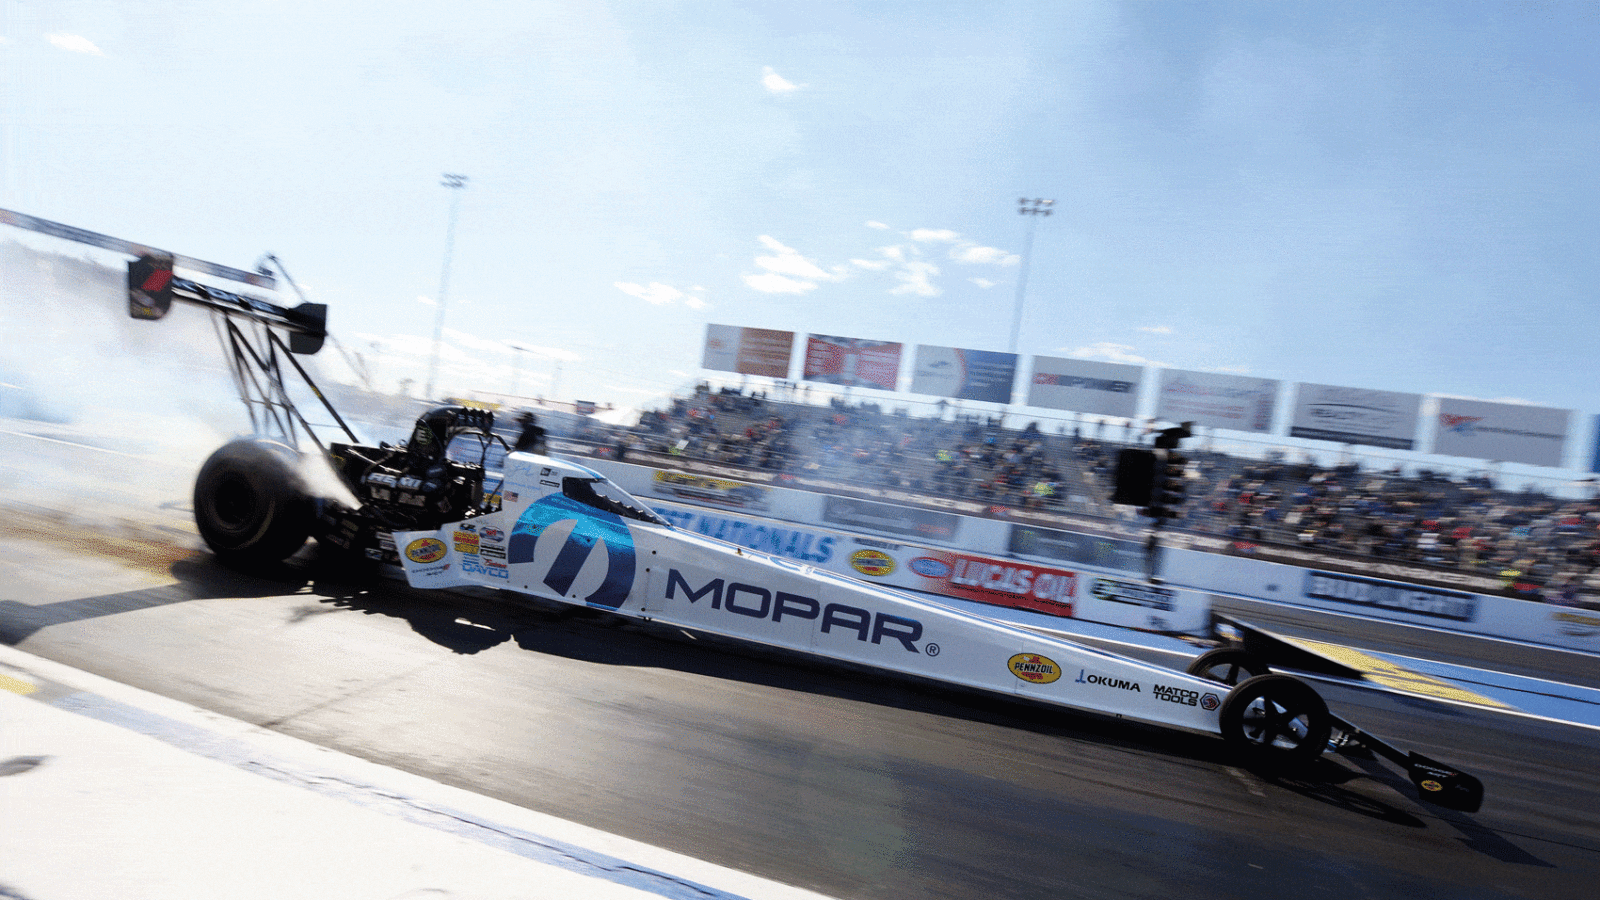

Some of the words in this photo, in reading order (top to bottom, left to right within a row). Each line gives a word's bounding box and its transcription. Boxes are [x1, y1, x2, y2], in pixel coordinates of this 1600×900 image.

[462, 563, 509, 579] DAYCO
[950, 558, 1034, 594] LUCAS
[1033, 573, 1074, 604] OIL
[665, 568, 923, 654] MOPAR
[1014, 662, 1055, 675] PENNZOIL
[1087, 674, 1141, 693] OKUMA
[1154, 684, 1199, 699] MATCO
[1153, 691, 1198, 707] TOOLS
